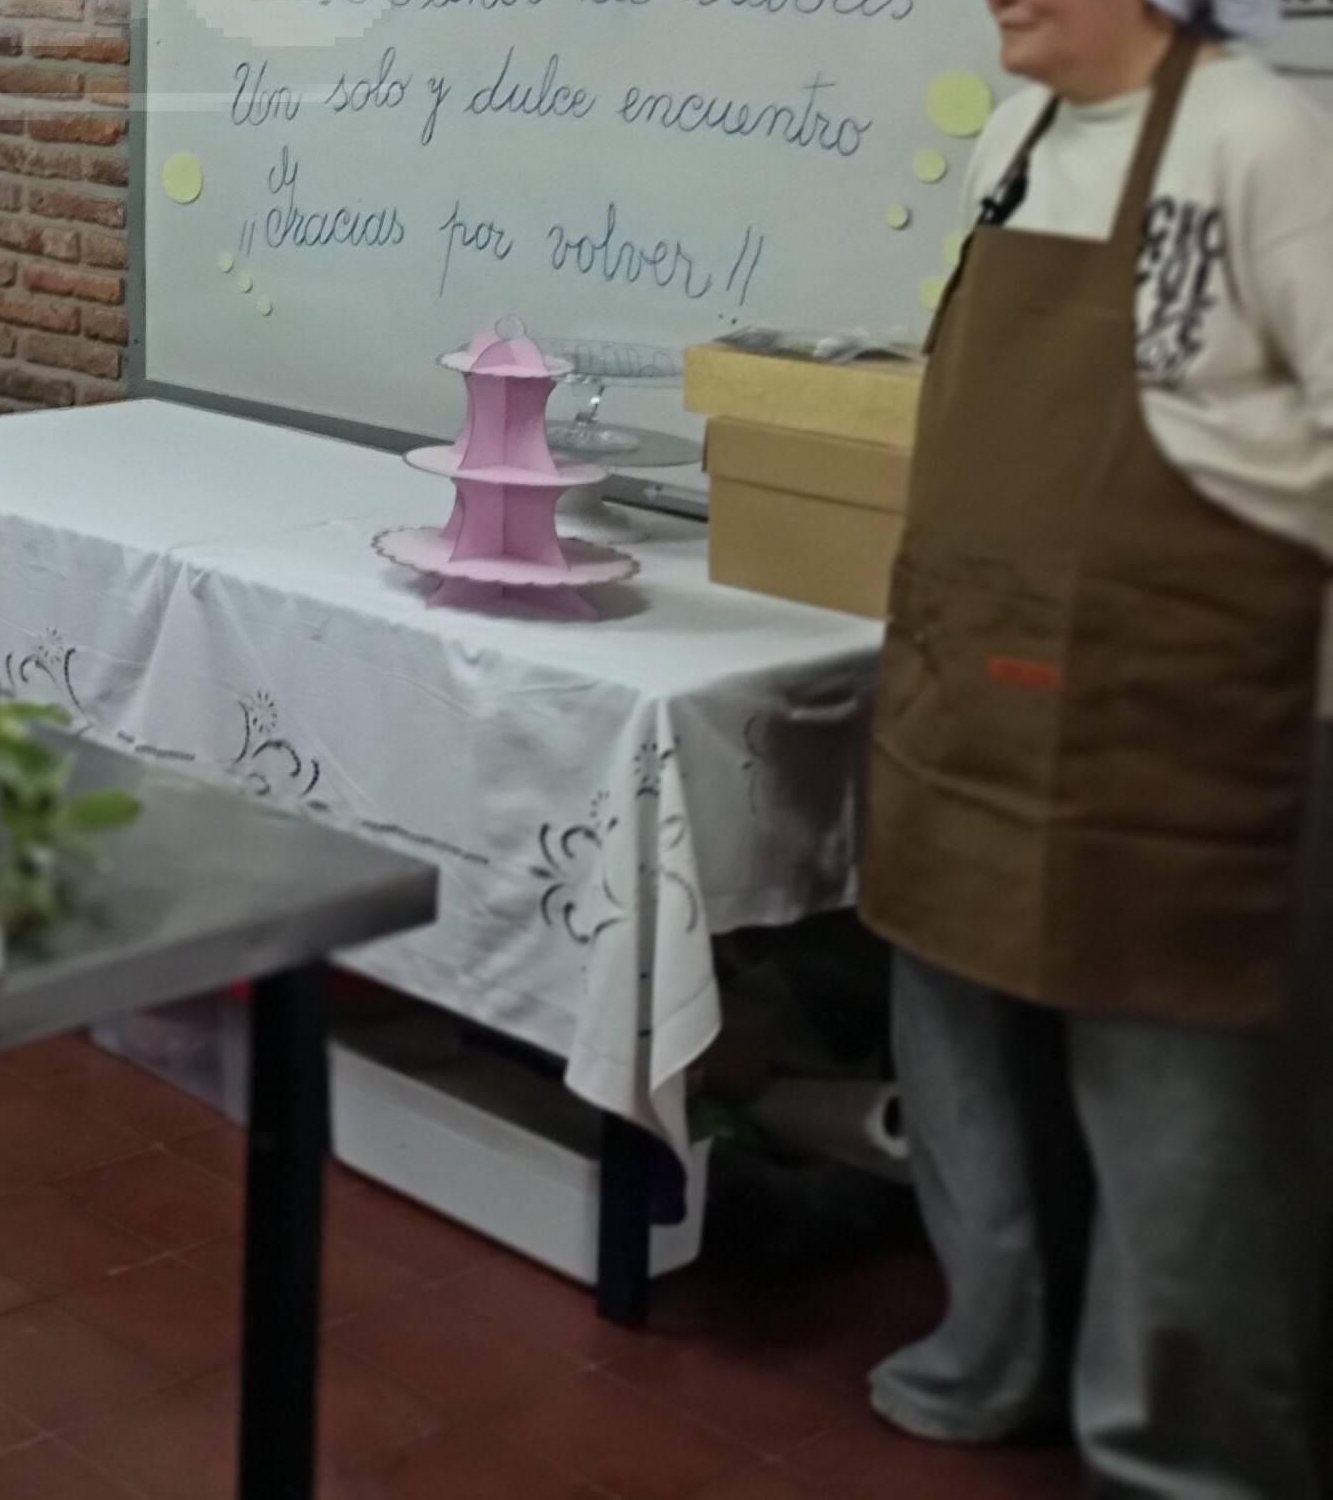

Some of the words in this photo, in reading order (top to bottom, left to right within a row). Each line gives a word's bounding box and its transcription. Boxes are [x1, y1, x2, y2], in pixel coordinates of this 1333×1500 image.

[324, 45, 414, 114] solo
[420, 75, 452, 146] y
[471, 46, 598, 119] dulce
[616, 72, 876, 156] encuentro
[439, 200, 514, 299] por
